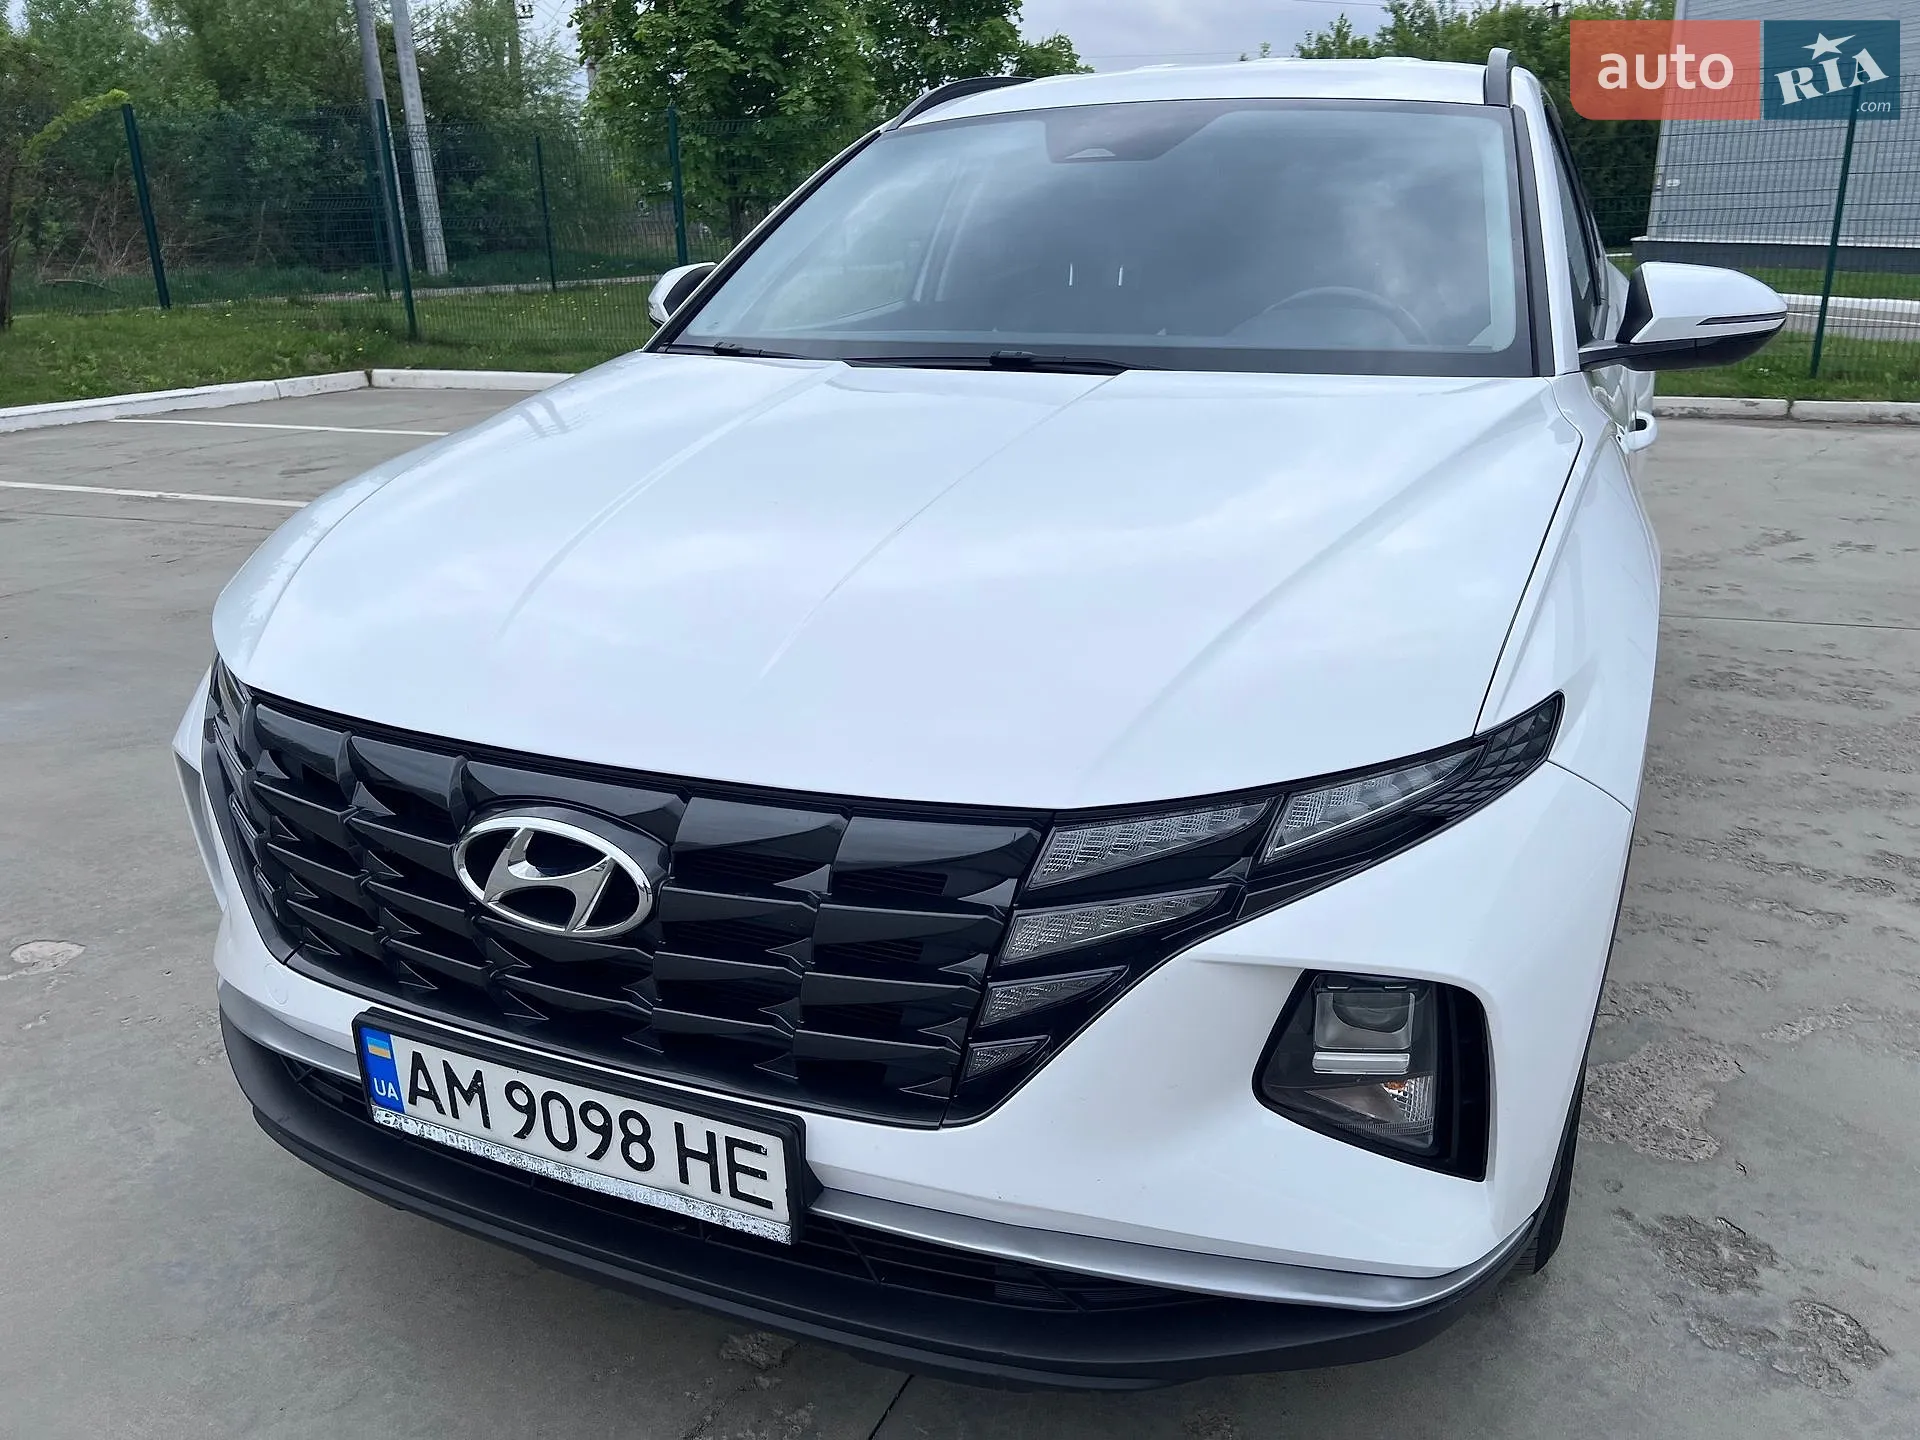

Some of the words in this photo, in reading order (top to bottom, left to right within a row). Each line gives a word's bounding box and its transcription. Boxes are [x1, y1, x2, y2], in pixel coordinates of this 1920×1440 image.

[374, 1077, 399, 1101] UA
[408, 1050, 491, 1129] AM
[504, 1080, 655, 1171] 9098
[674, 1122, 774, 1209] HE
